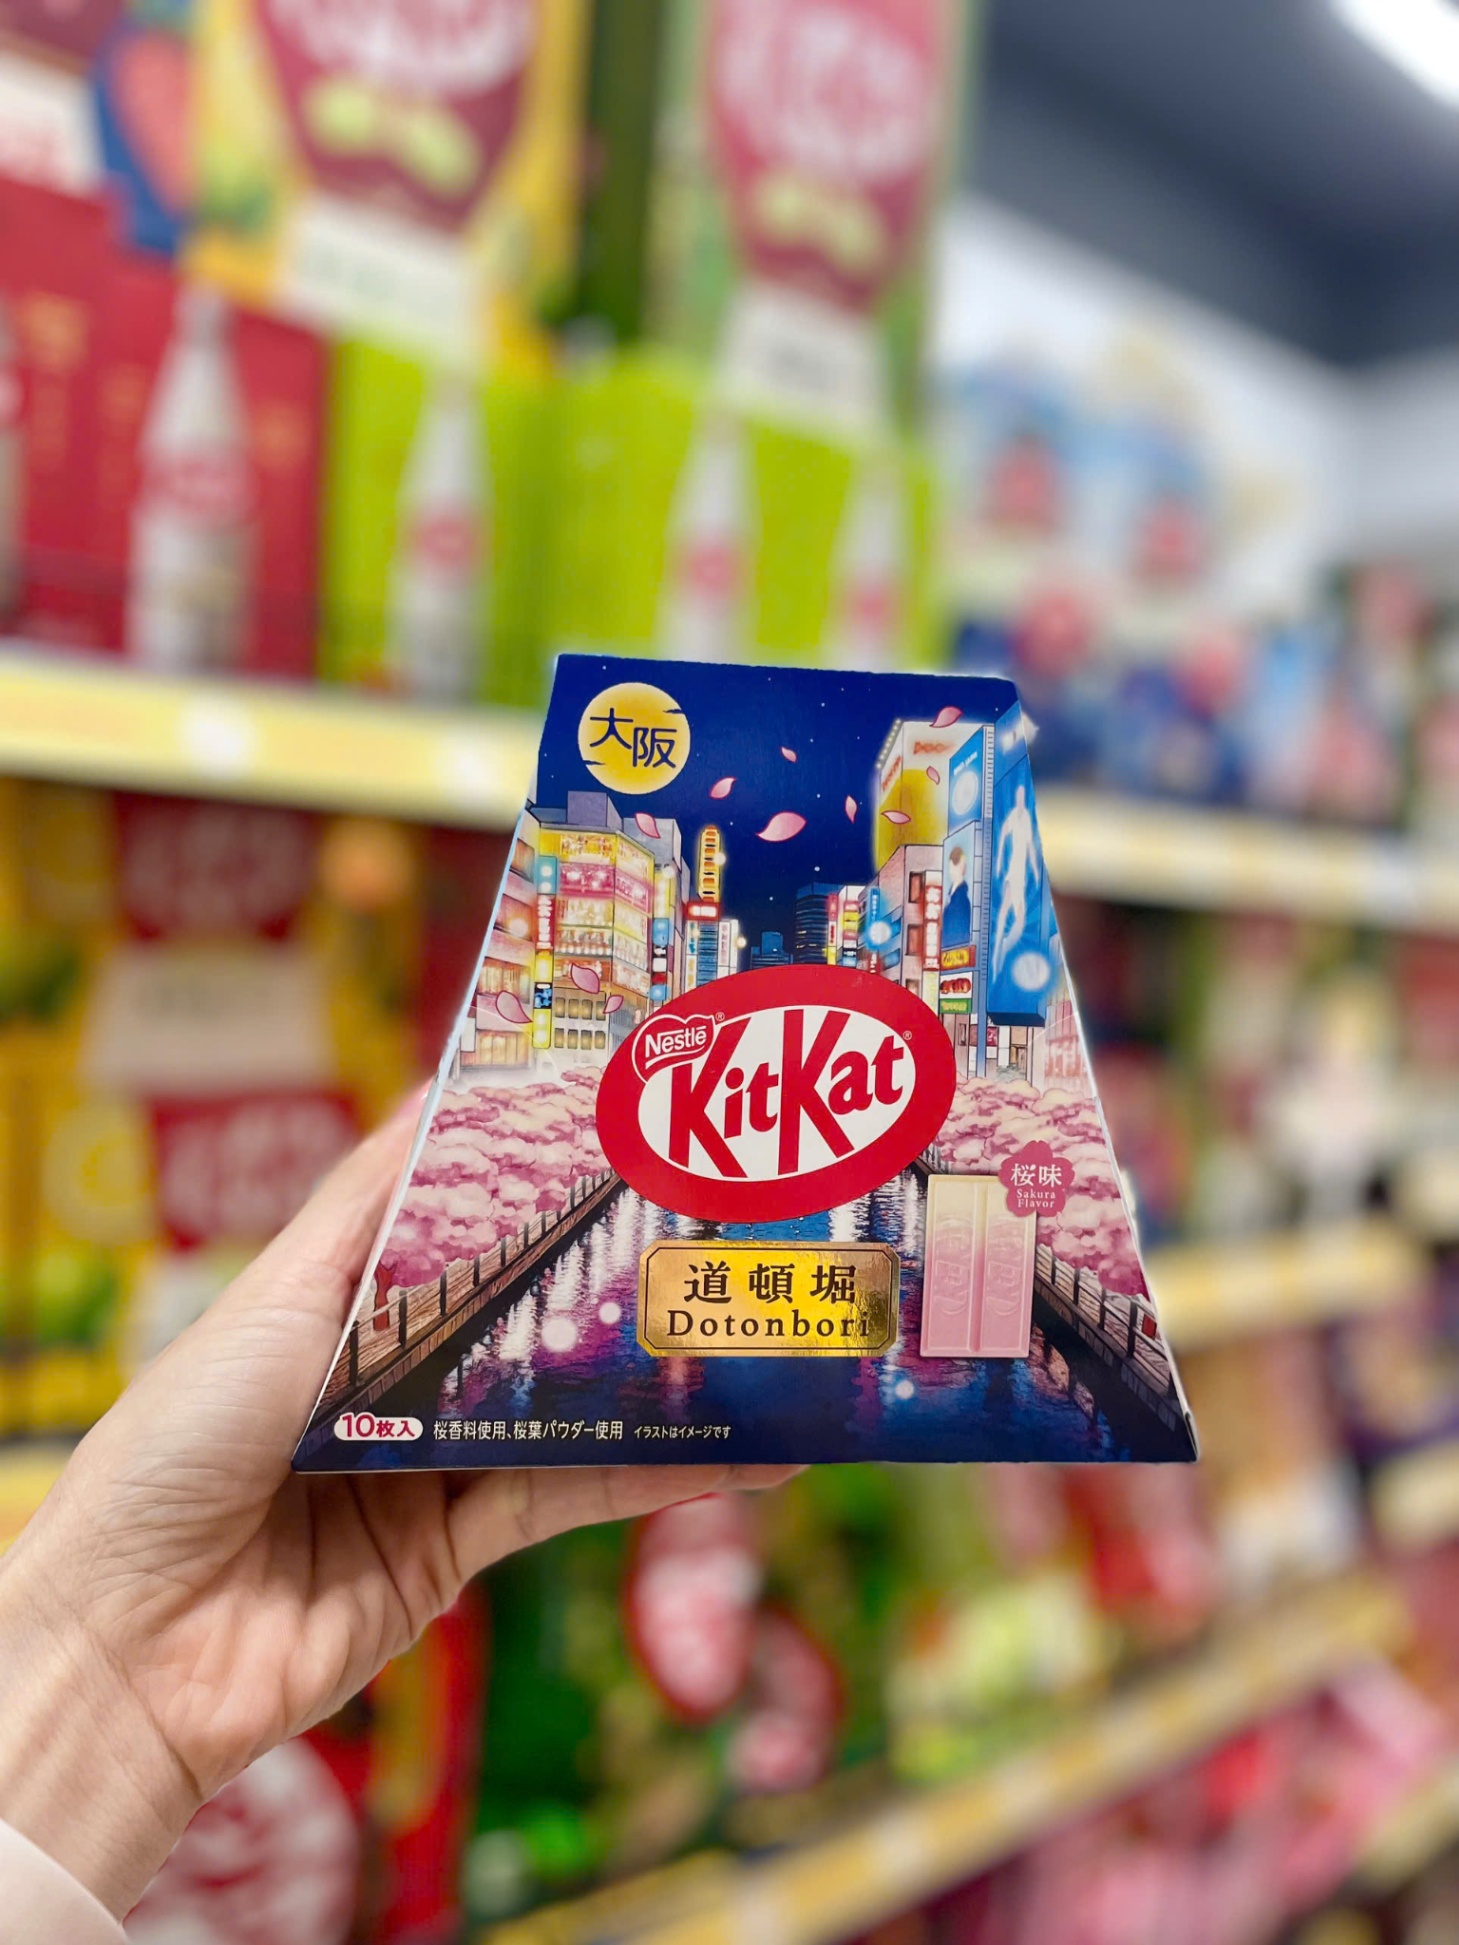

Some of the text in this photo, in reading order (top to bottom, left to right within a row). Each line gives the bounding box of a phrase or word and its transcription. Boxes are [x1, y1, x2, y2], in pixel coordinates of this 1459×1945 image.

[590, 708, 677, 768] 大阪
[668, 1009, 904, 1178] KitKat
[1011, 1164, 1062, 1187] 桜味
[1016, 1189, 1056, 1199] Sakura
[1018, 1199, 1055, 1208] Flavor
[683, 1260, 857, 1304] 道頓堀
[666, 1309, 869, 1337] Dotonbori
[342, 1414, 415, 1438] 10枚入
[634, 1425, 731, 1439] イラストはイメージです
